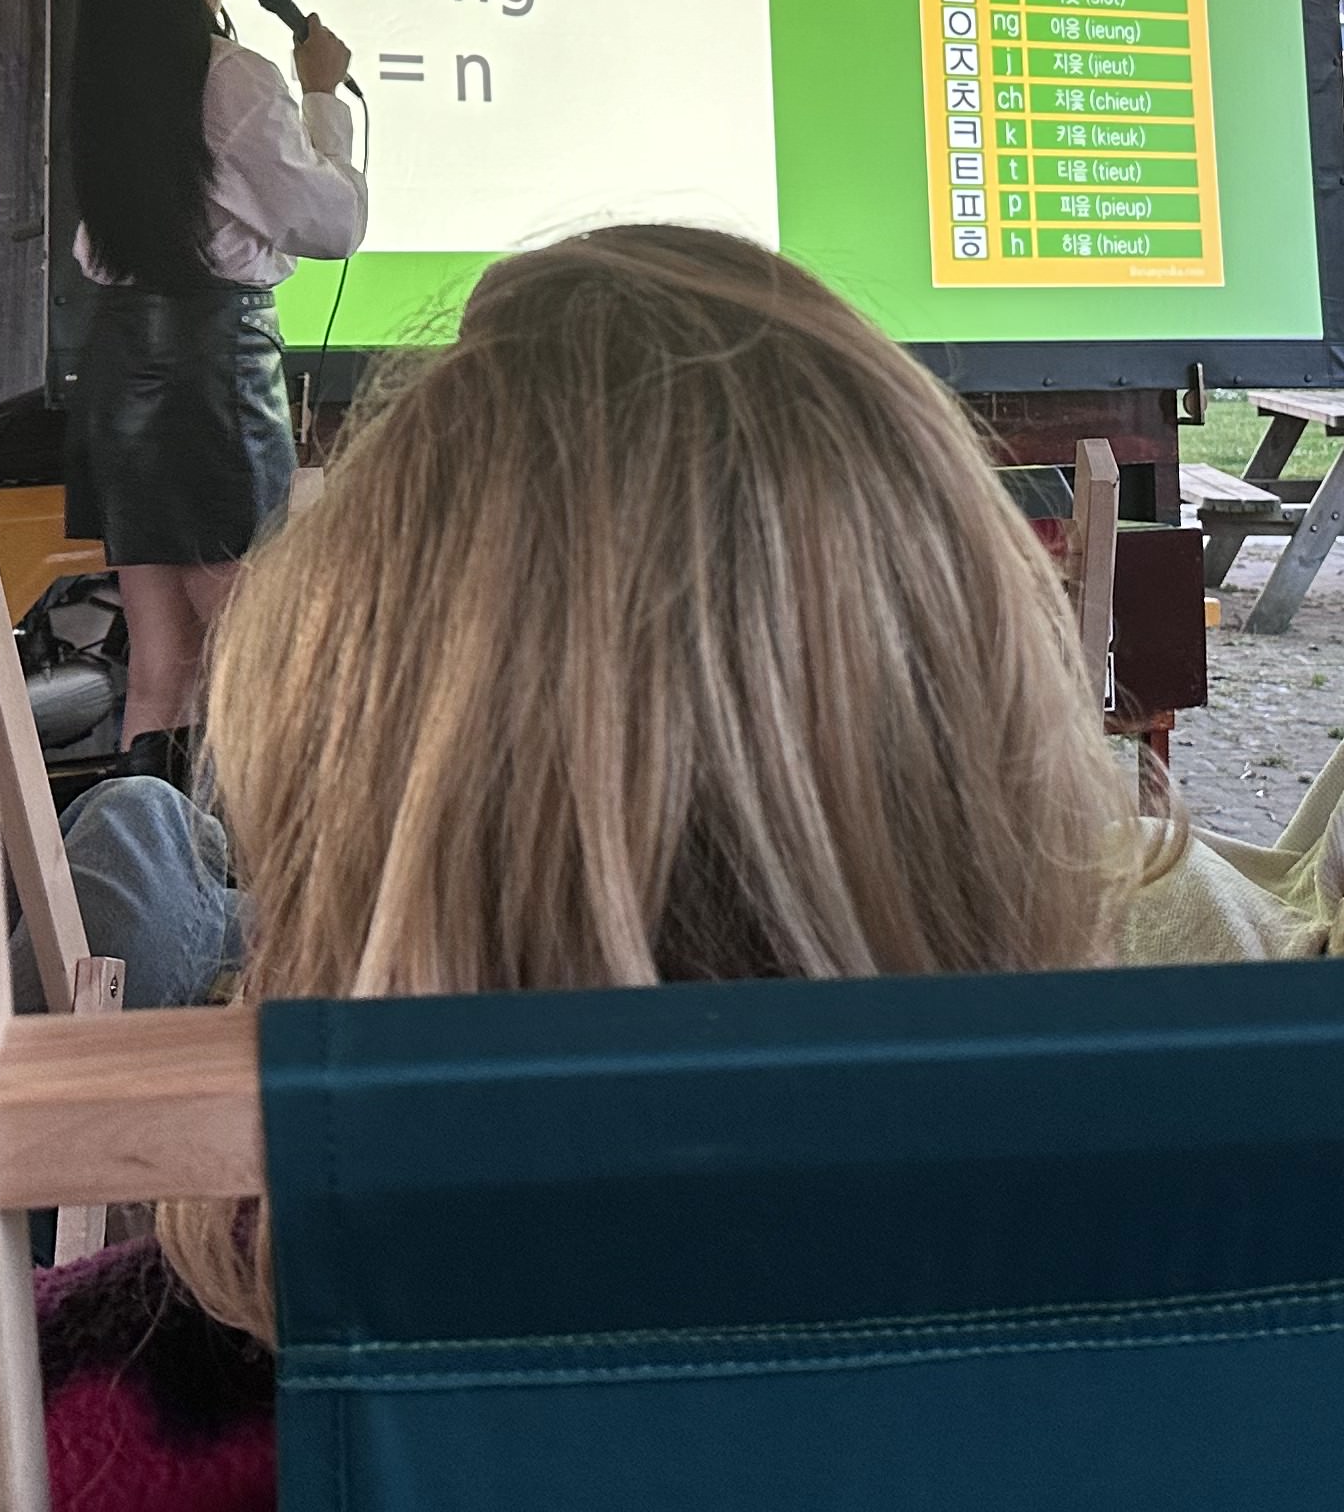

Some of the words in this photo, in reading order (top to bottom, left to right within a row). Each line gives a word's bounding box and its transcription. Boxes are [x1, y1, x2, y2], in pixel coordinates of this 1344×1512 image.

[994, 12, 1019, 37] ng
[1050, 17, 1080, 40] 이응
[1085, 17, 1141, 44] (ieung)
[1005, 49, 1012, 75] j
[1053, 53, 1084, 76] 지읒
[1088, 52, 1135, 77] (jieut)
[455, 53, 493, 103] n
[998, 87, 1022, 109] ch
[1089, 88, 1152, 114] (chieut)
[1005, 124, 1017, 145] k
[1091, 124, 1145, 148] (kieuk)
[1009, 159, 1018, 180] t
[1092, 160, 1142, 184] (tieut)
[1008, 194, 1022, 216] p
[1095, 196, 1152, 220] (pieup)
[1011, 232, 1024, 255] h
[1097, 233, 1150, 257] (hieut)
